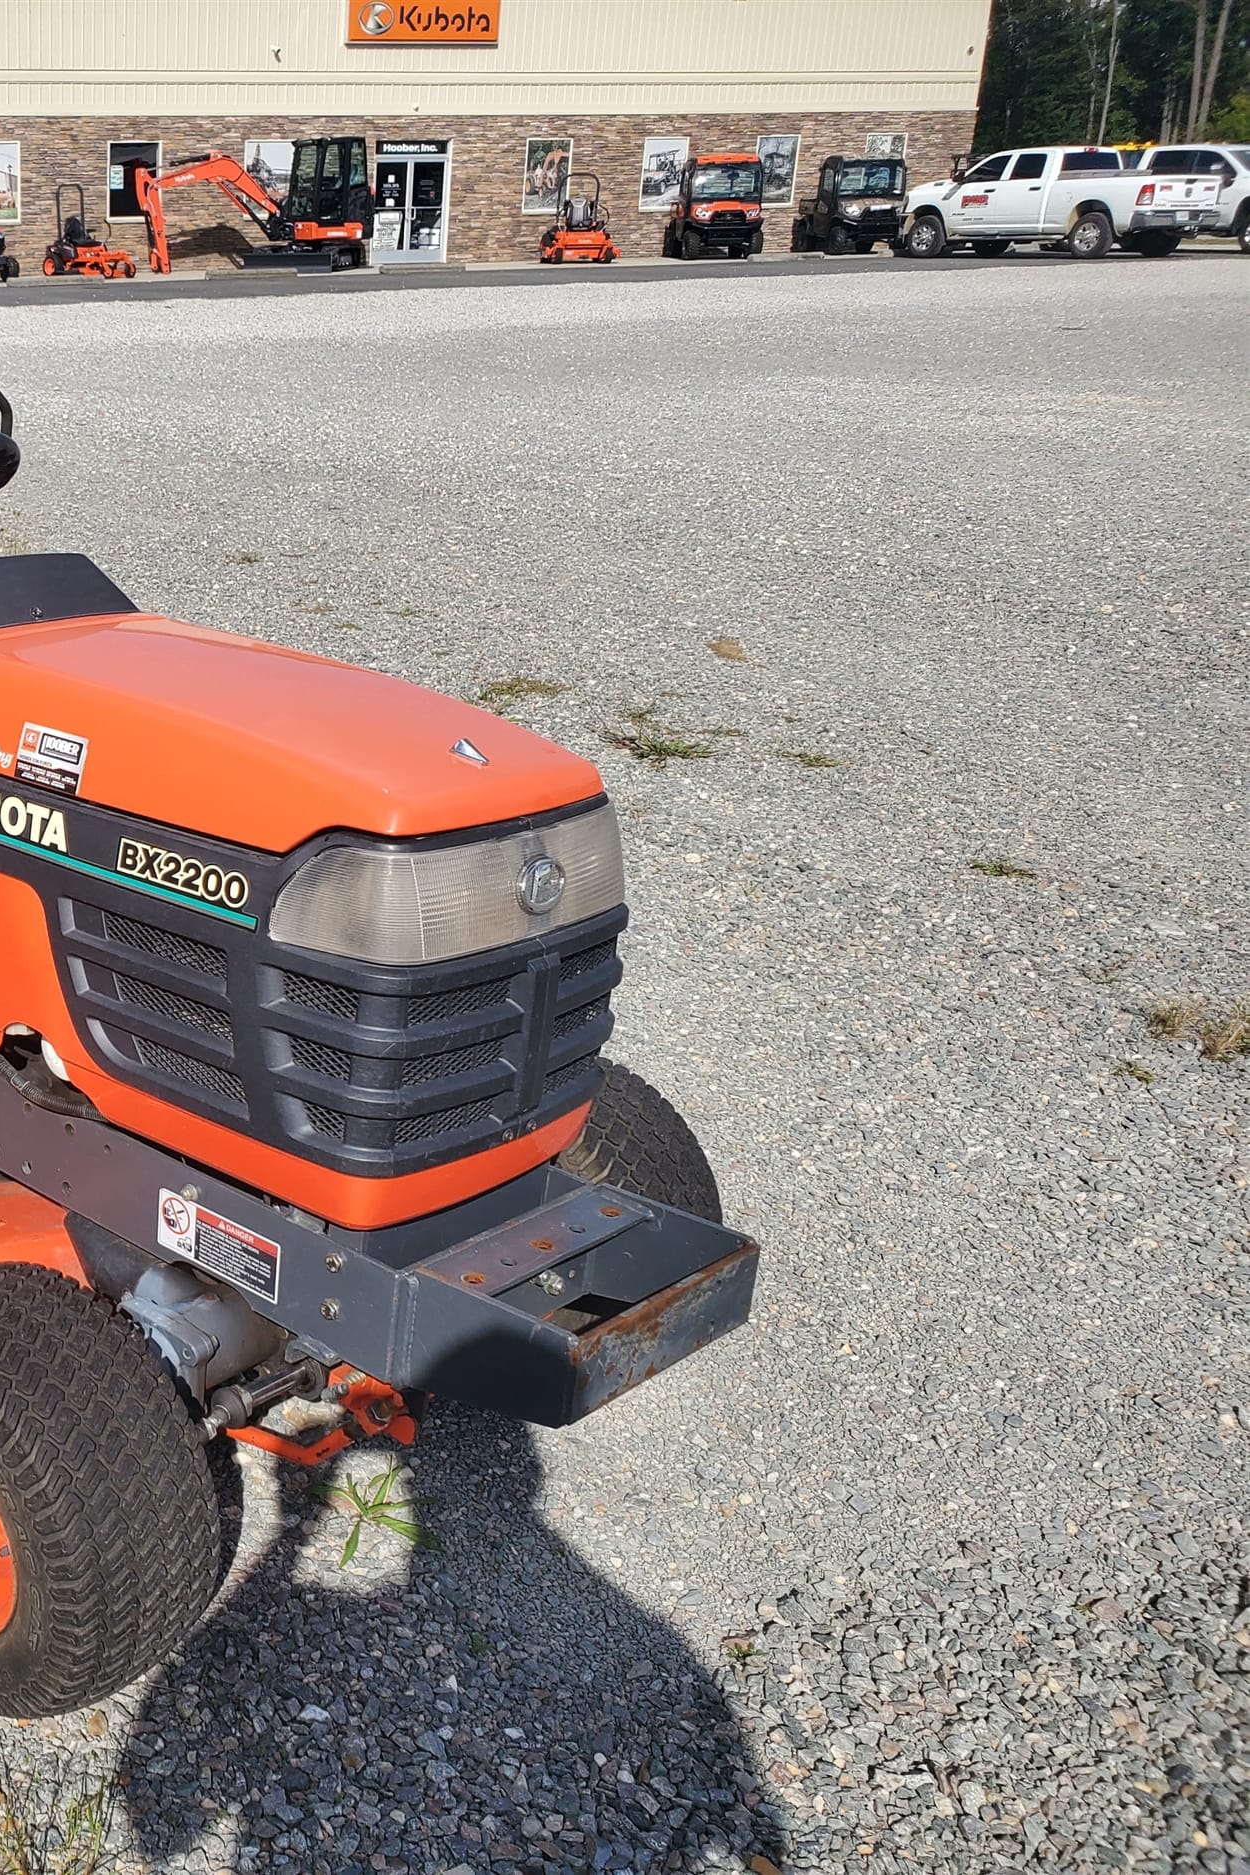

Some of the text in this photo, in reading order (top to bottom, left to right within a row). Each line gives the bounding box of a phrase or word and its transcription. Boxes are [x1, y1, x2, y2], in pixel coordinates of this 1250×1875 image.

[399, 5, 491, 32] Kubota
[383, 143, 438, 153] Hoober, Inc.
[116, 837, 249, 908] BX2200
[226, 1223, 255, 1245] DANGER
